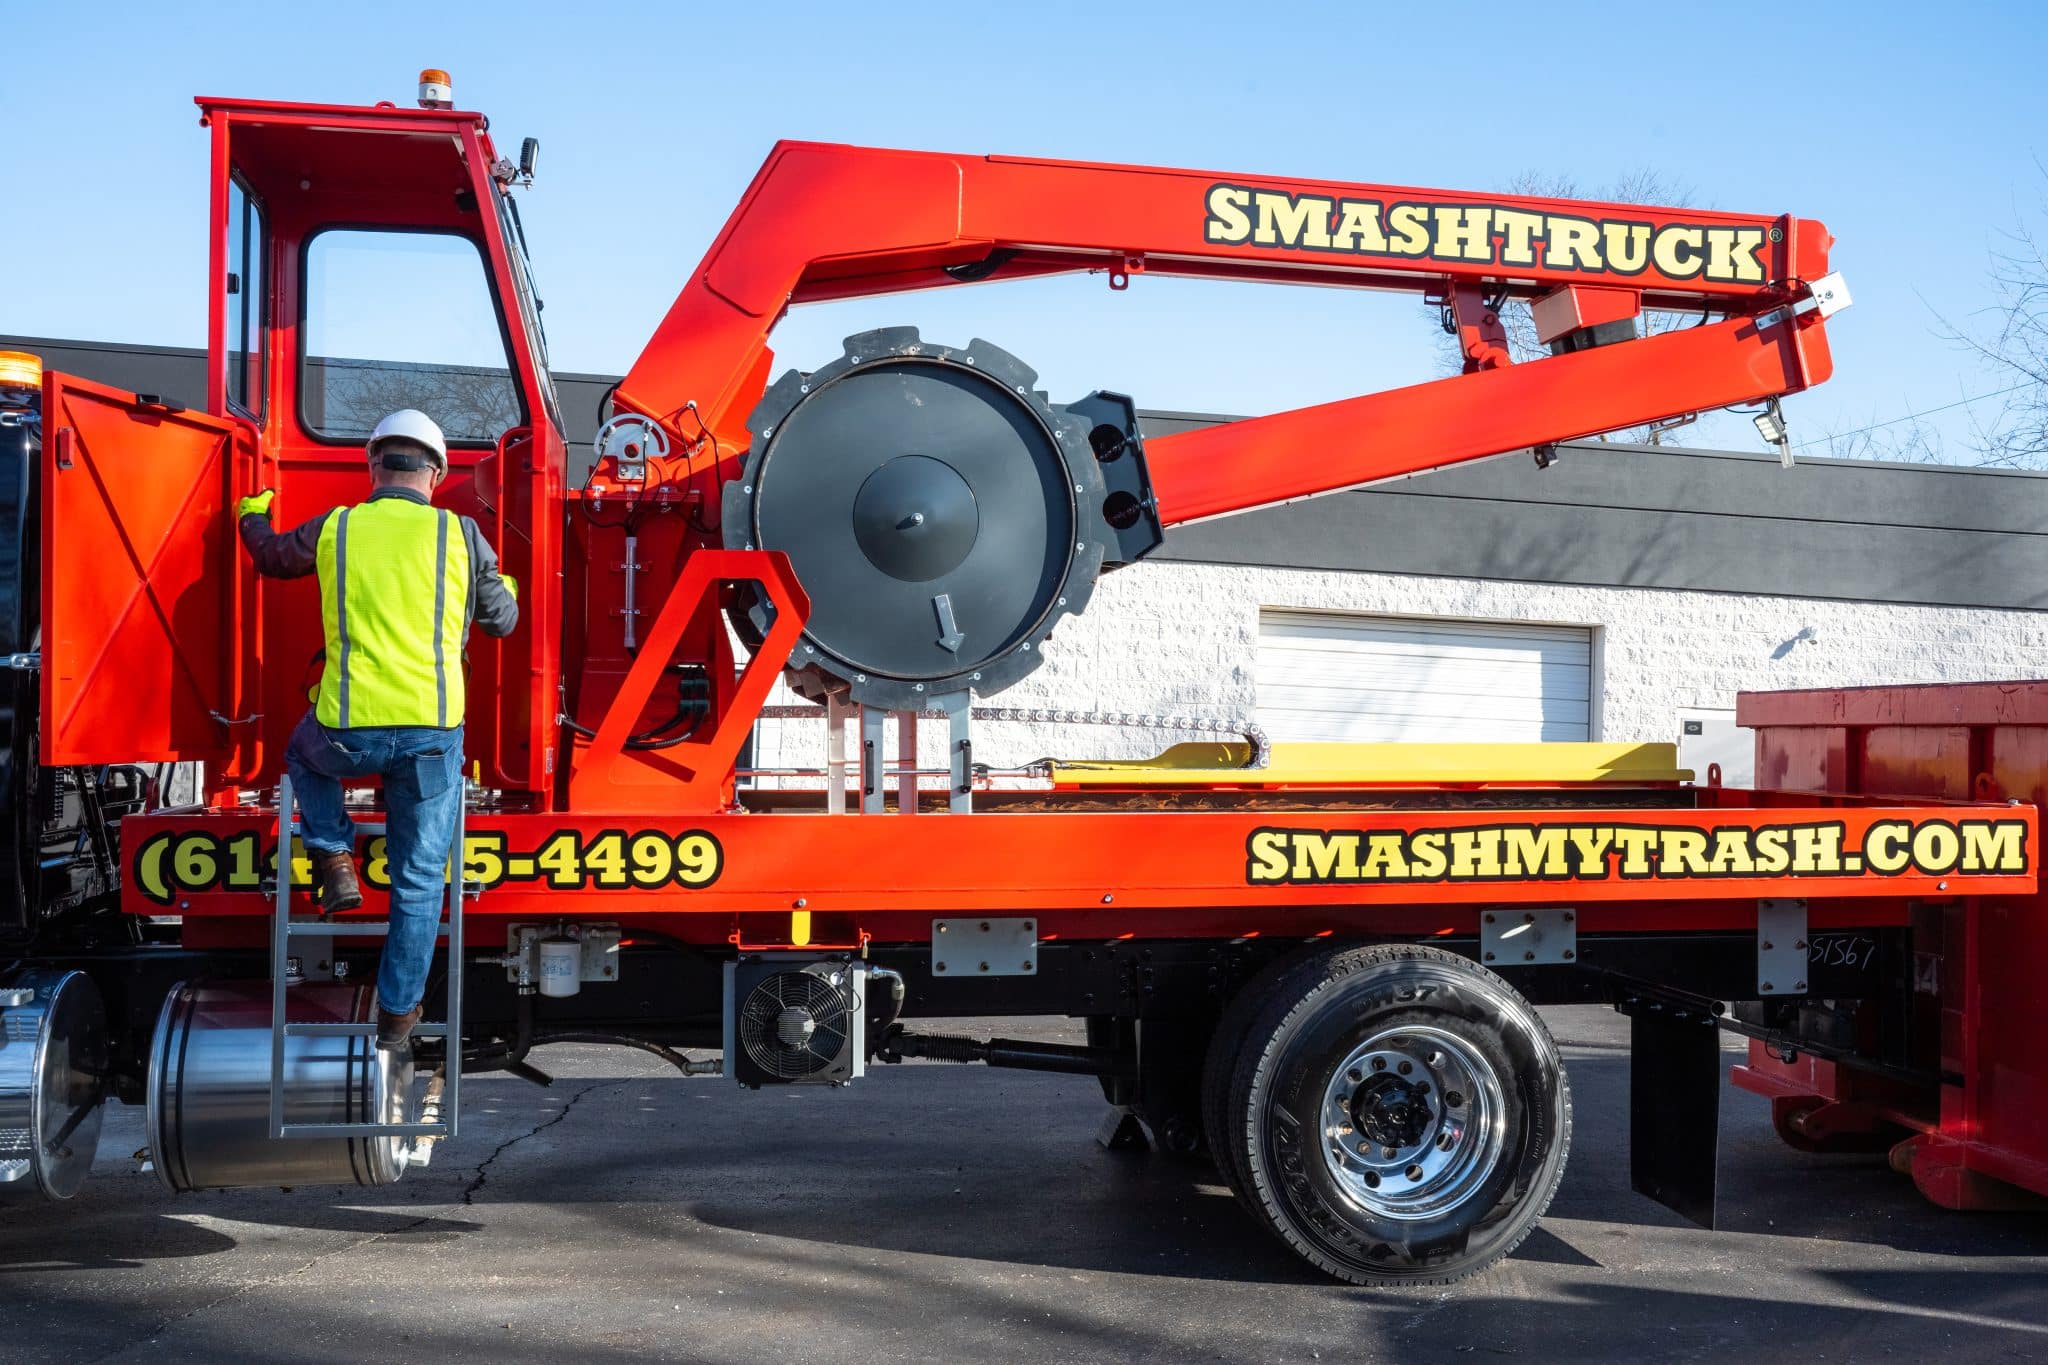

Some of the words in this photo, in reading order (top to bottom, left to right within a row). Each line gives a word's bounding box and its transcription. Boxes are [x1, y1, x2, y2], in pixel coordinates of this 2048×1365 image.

[139, 835, 328, 900] (614
[365, 834, 719, 886] 85-4499
[1249, 822, 2026, 882] SMASHMYTRASH.COM
[1808, 937, 1875, 971] 51567
